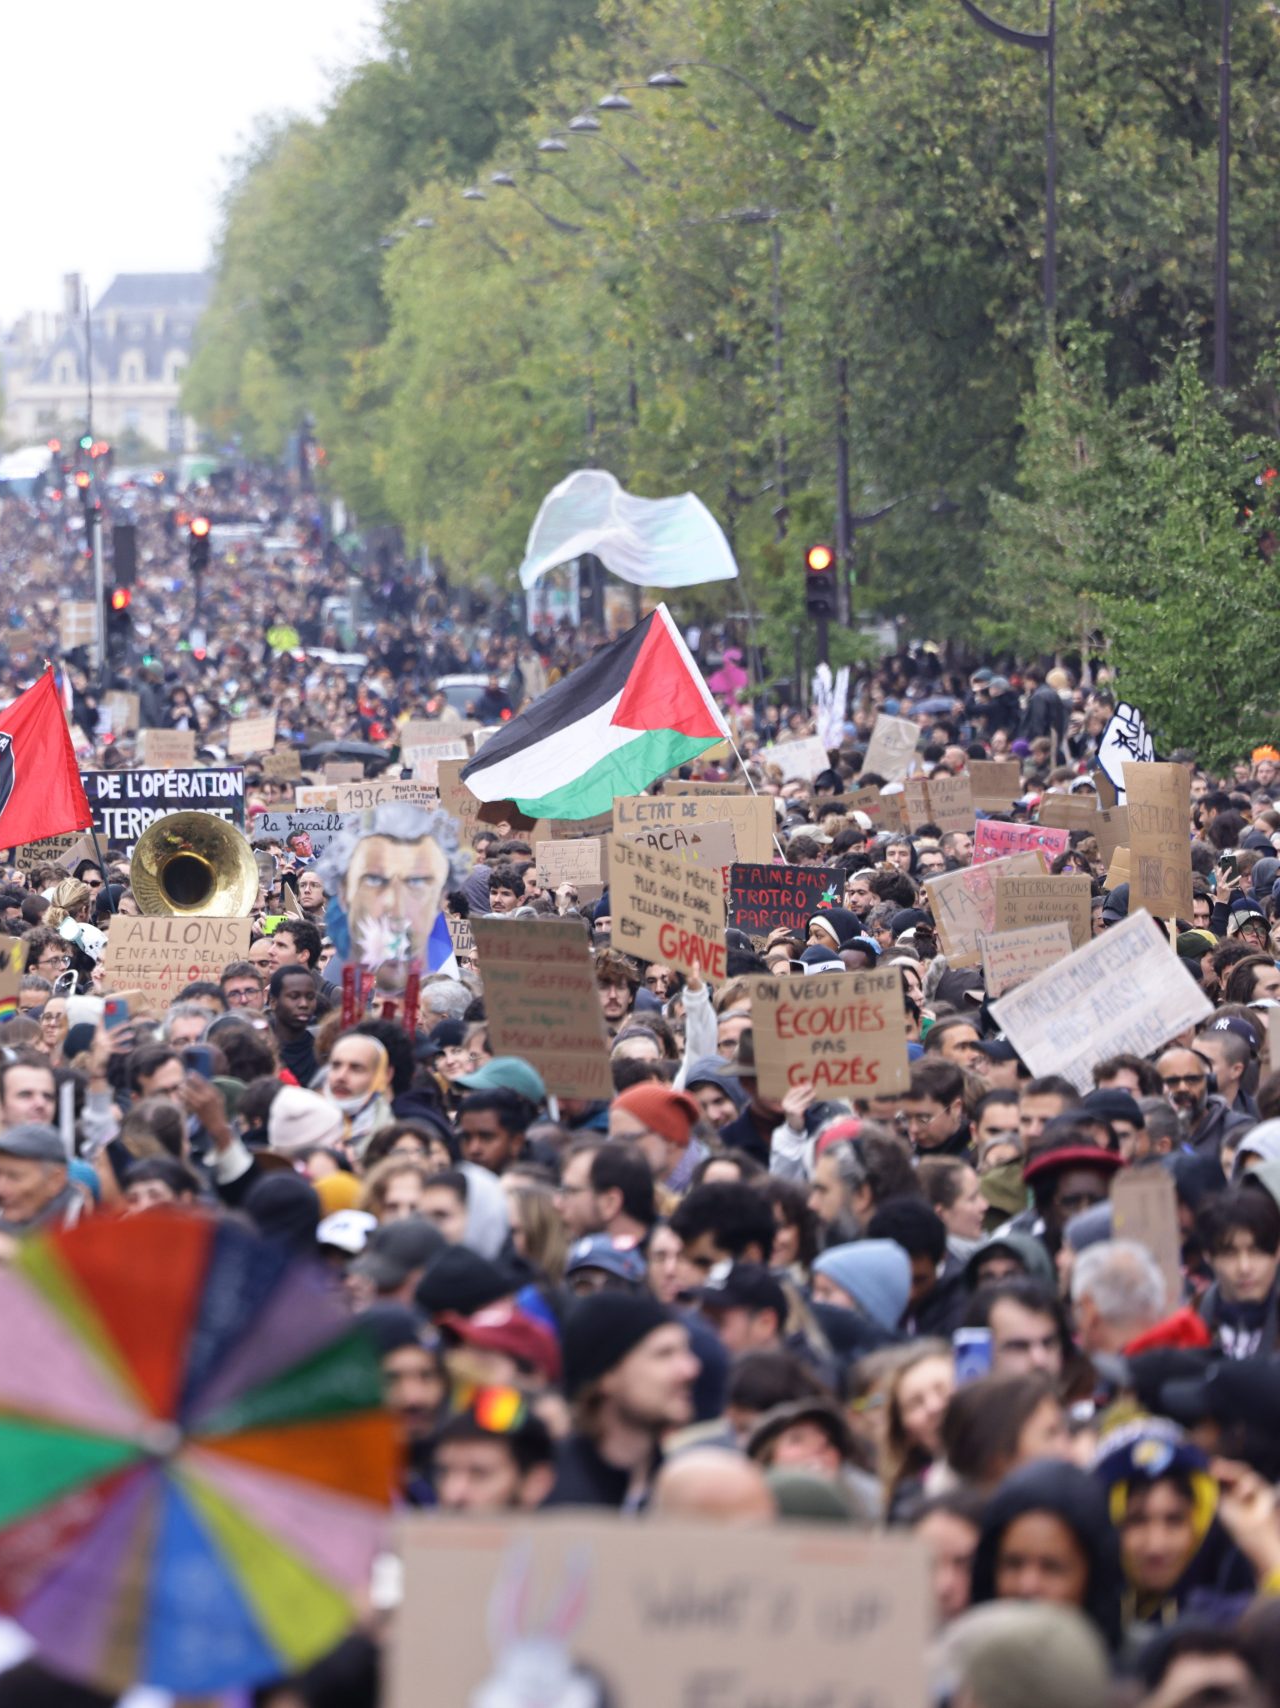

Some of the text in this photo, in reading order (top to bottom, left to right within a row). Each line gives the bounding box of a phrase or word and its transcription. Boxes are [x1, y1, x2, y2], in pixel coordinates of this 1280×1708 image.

[97, 769, 243, 799] DE L'OPÉRATION
[344, 788, 387, 808] 1936
[682, 802, 698, 818] DE
[261, 814, 280, 831] la
[686, 867, 719, 897] MÊME
[1003, 881, 1089, 896] INTERDICTIONS
[733, 888, 807, 909] TROTRO
[1027, 901, 1079, 912] CIRCULER
[629, 895, 720, 939] TELLEMENT TOUT
[115, 947, 186, 961] ENFANTS
[621, 916, 727, 980] EST GRAVE
[756, 973, 896, 1001] ON VEUT ÊTRE
[775, 999, 886, 1040] ÉCOUTÉS
[811, 1038, 847, 1054] PAS
[787, 1056, 881, 1088] GAZÉS
